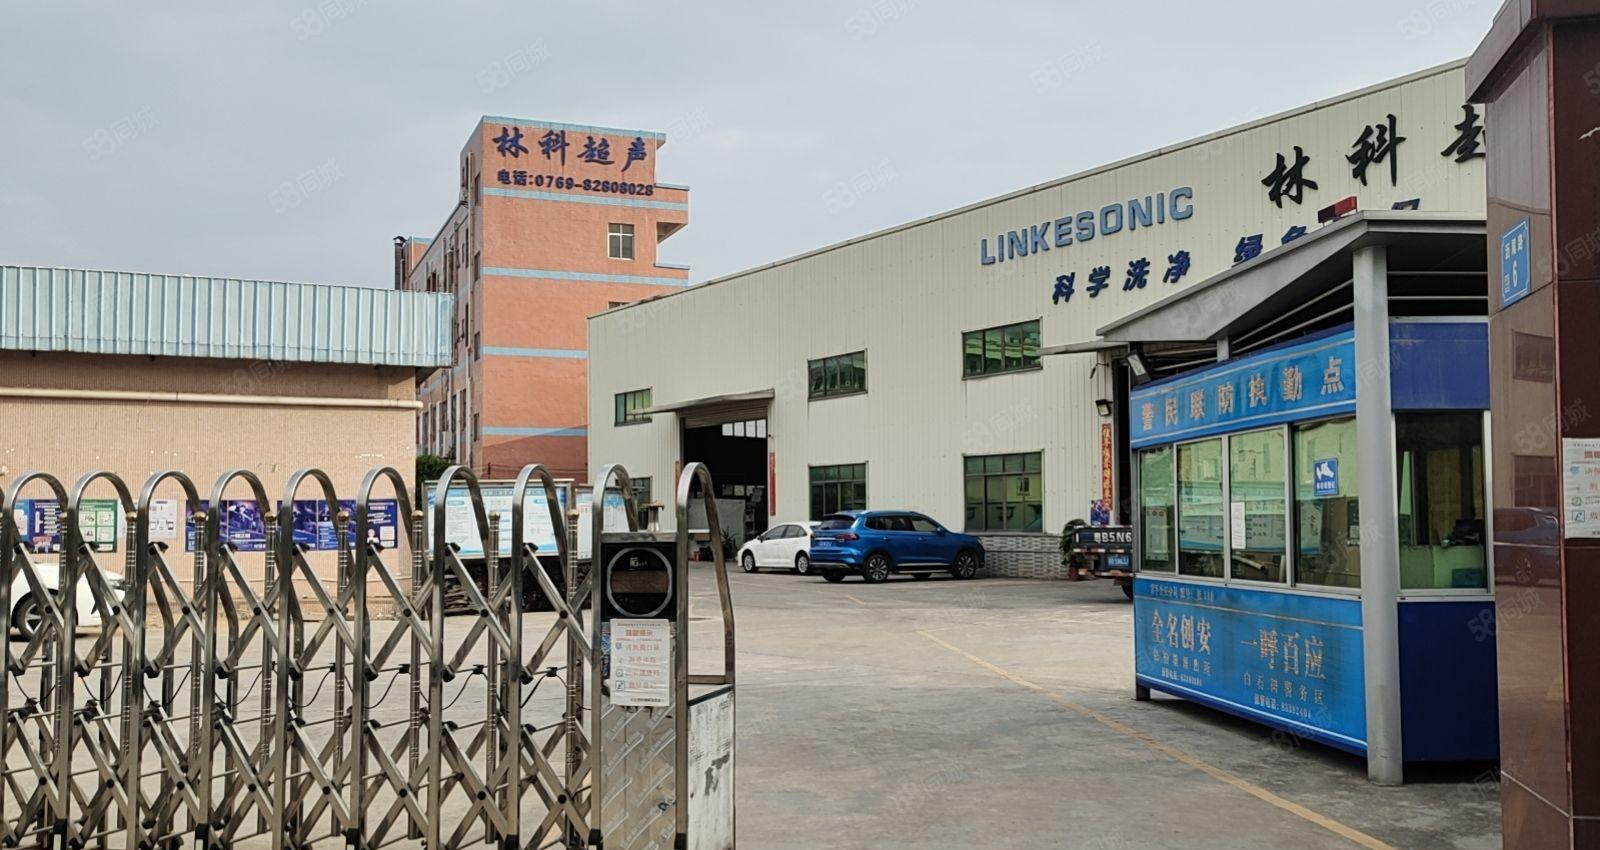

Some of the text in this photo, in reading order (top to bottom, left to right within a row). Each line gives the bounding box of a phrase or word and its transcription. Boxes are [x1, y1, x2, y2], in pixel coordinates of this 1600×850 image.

[492, 126, 647, 172] 林科超声
[981, 186, 1193, 266] LINKESONIC
[1052, 250, 1191, 305] 科学洗净
[1512, 259, 1518, 288] 6
[1141, 355, 1345, 432] 警民联防执勤点
